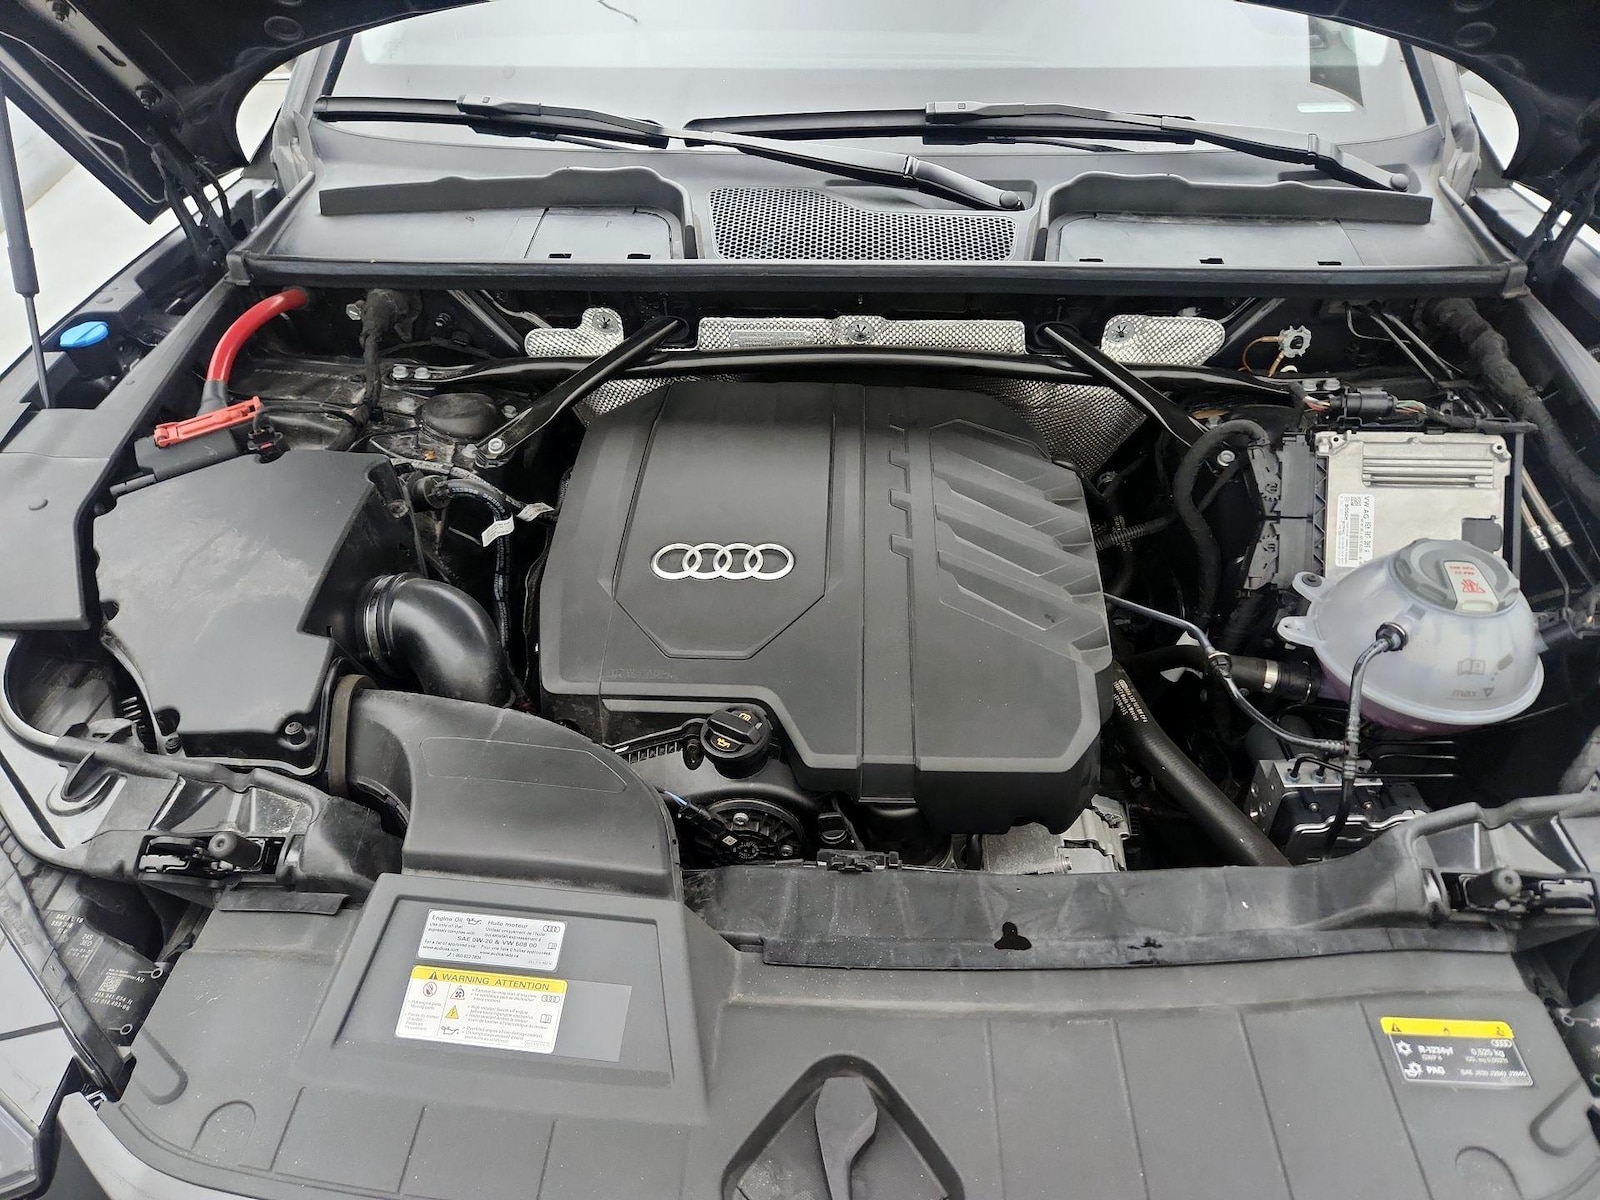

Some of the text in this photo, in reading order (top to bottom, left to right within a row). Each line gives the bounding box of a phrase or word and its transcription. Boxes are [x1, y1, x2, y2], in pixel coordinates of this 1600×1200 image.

[1453, 689, 1477, 698] max
[442, 973, 550, 991] WARNING ATTENTION
